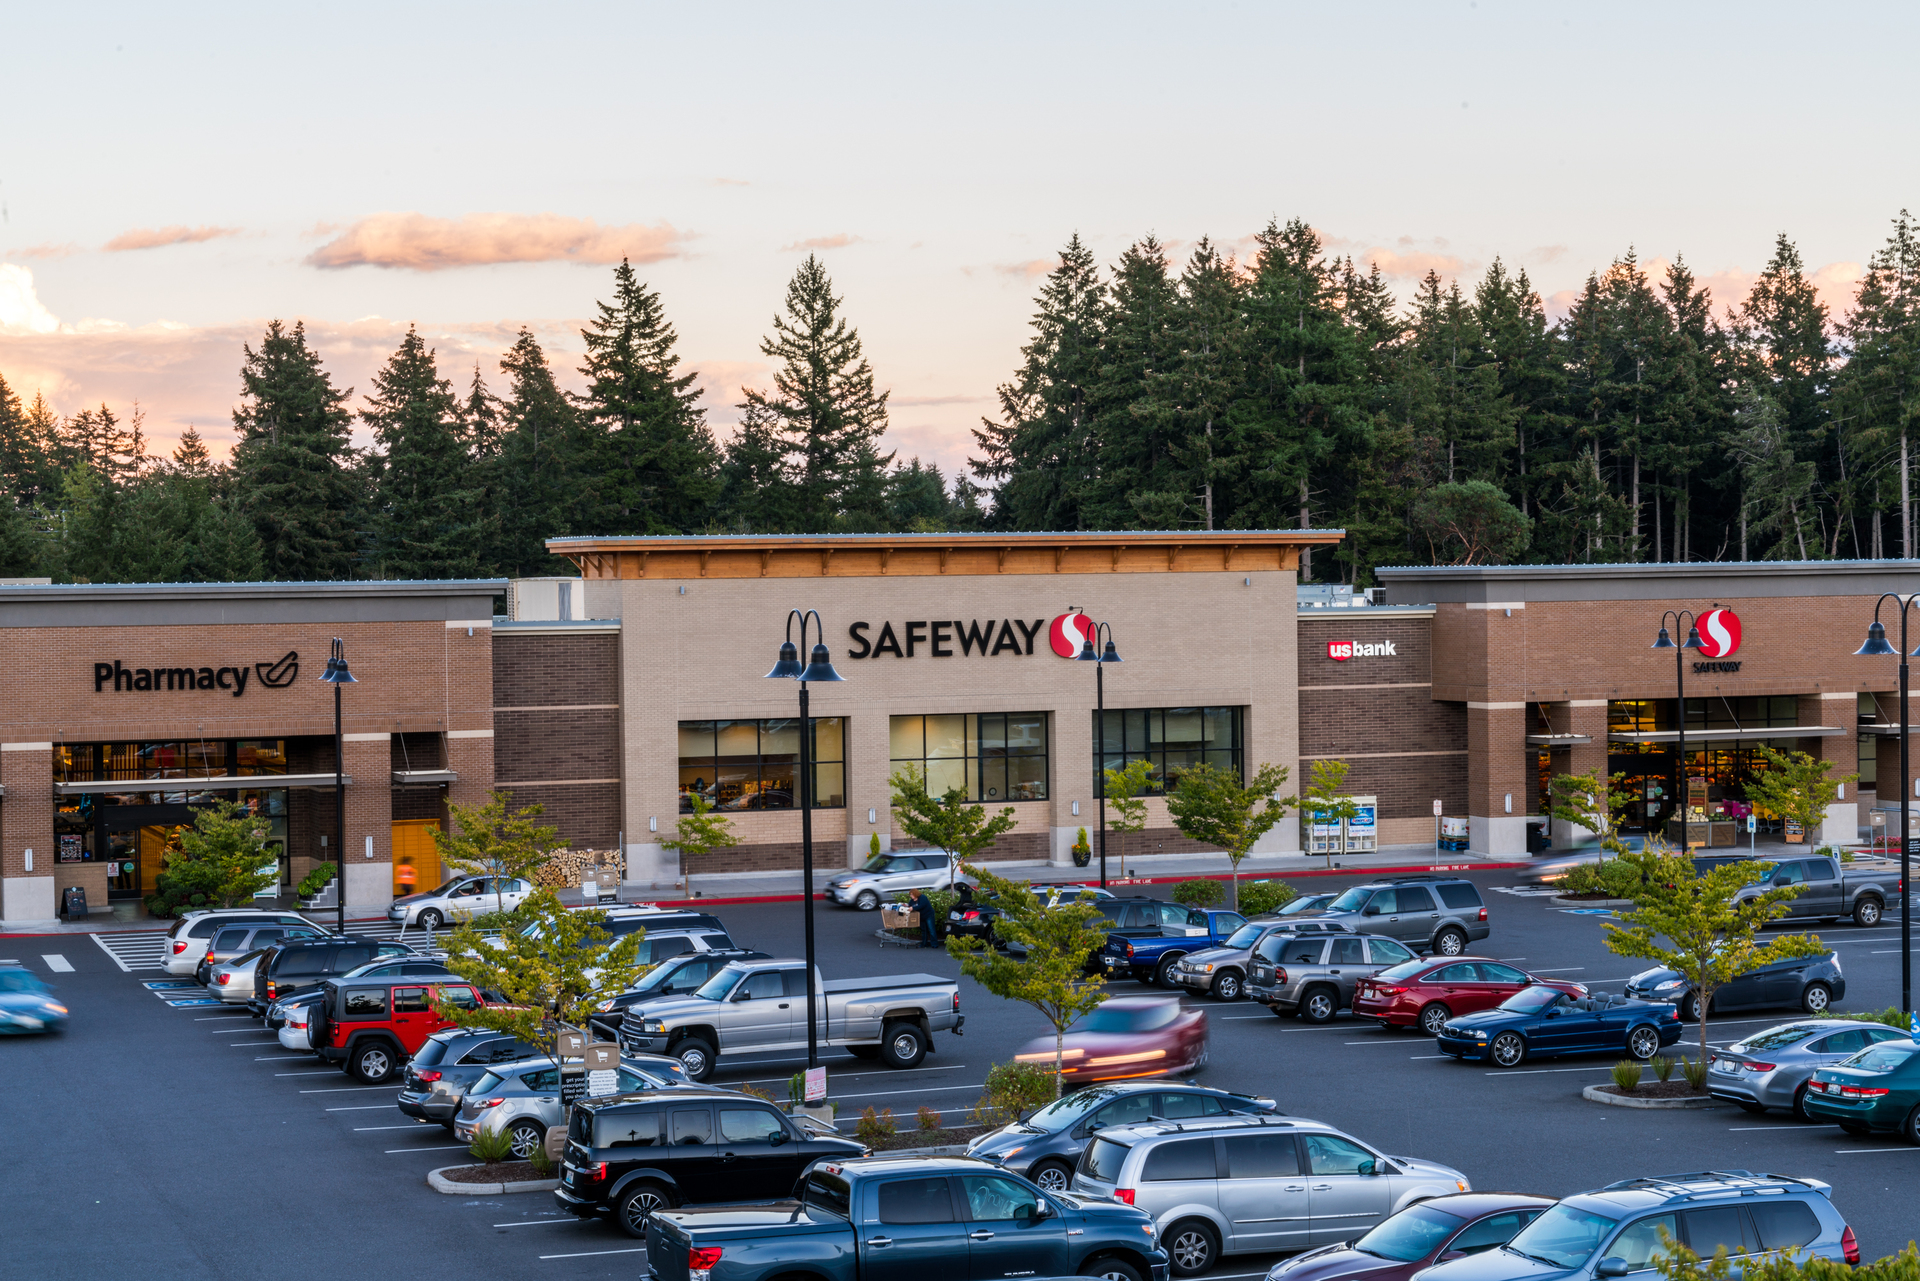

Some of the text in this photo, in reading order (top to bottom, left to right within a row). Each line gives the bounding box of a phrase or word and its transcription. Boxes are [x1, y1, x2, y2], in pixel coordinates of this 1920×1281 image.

[848, 619, 1045, 659] SAFEWAY
[94, 660, 250, 697] Pharmacy
[1692, 661, 1742, 673] SAFEWAY
